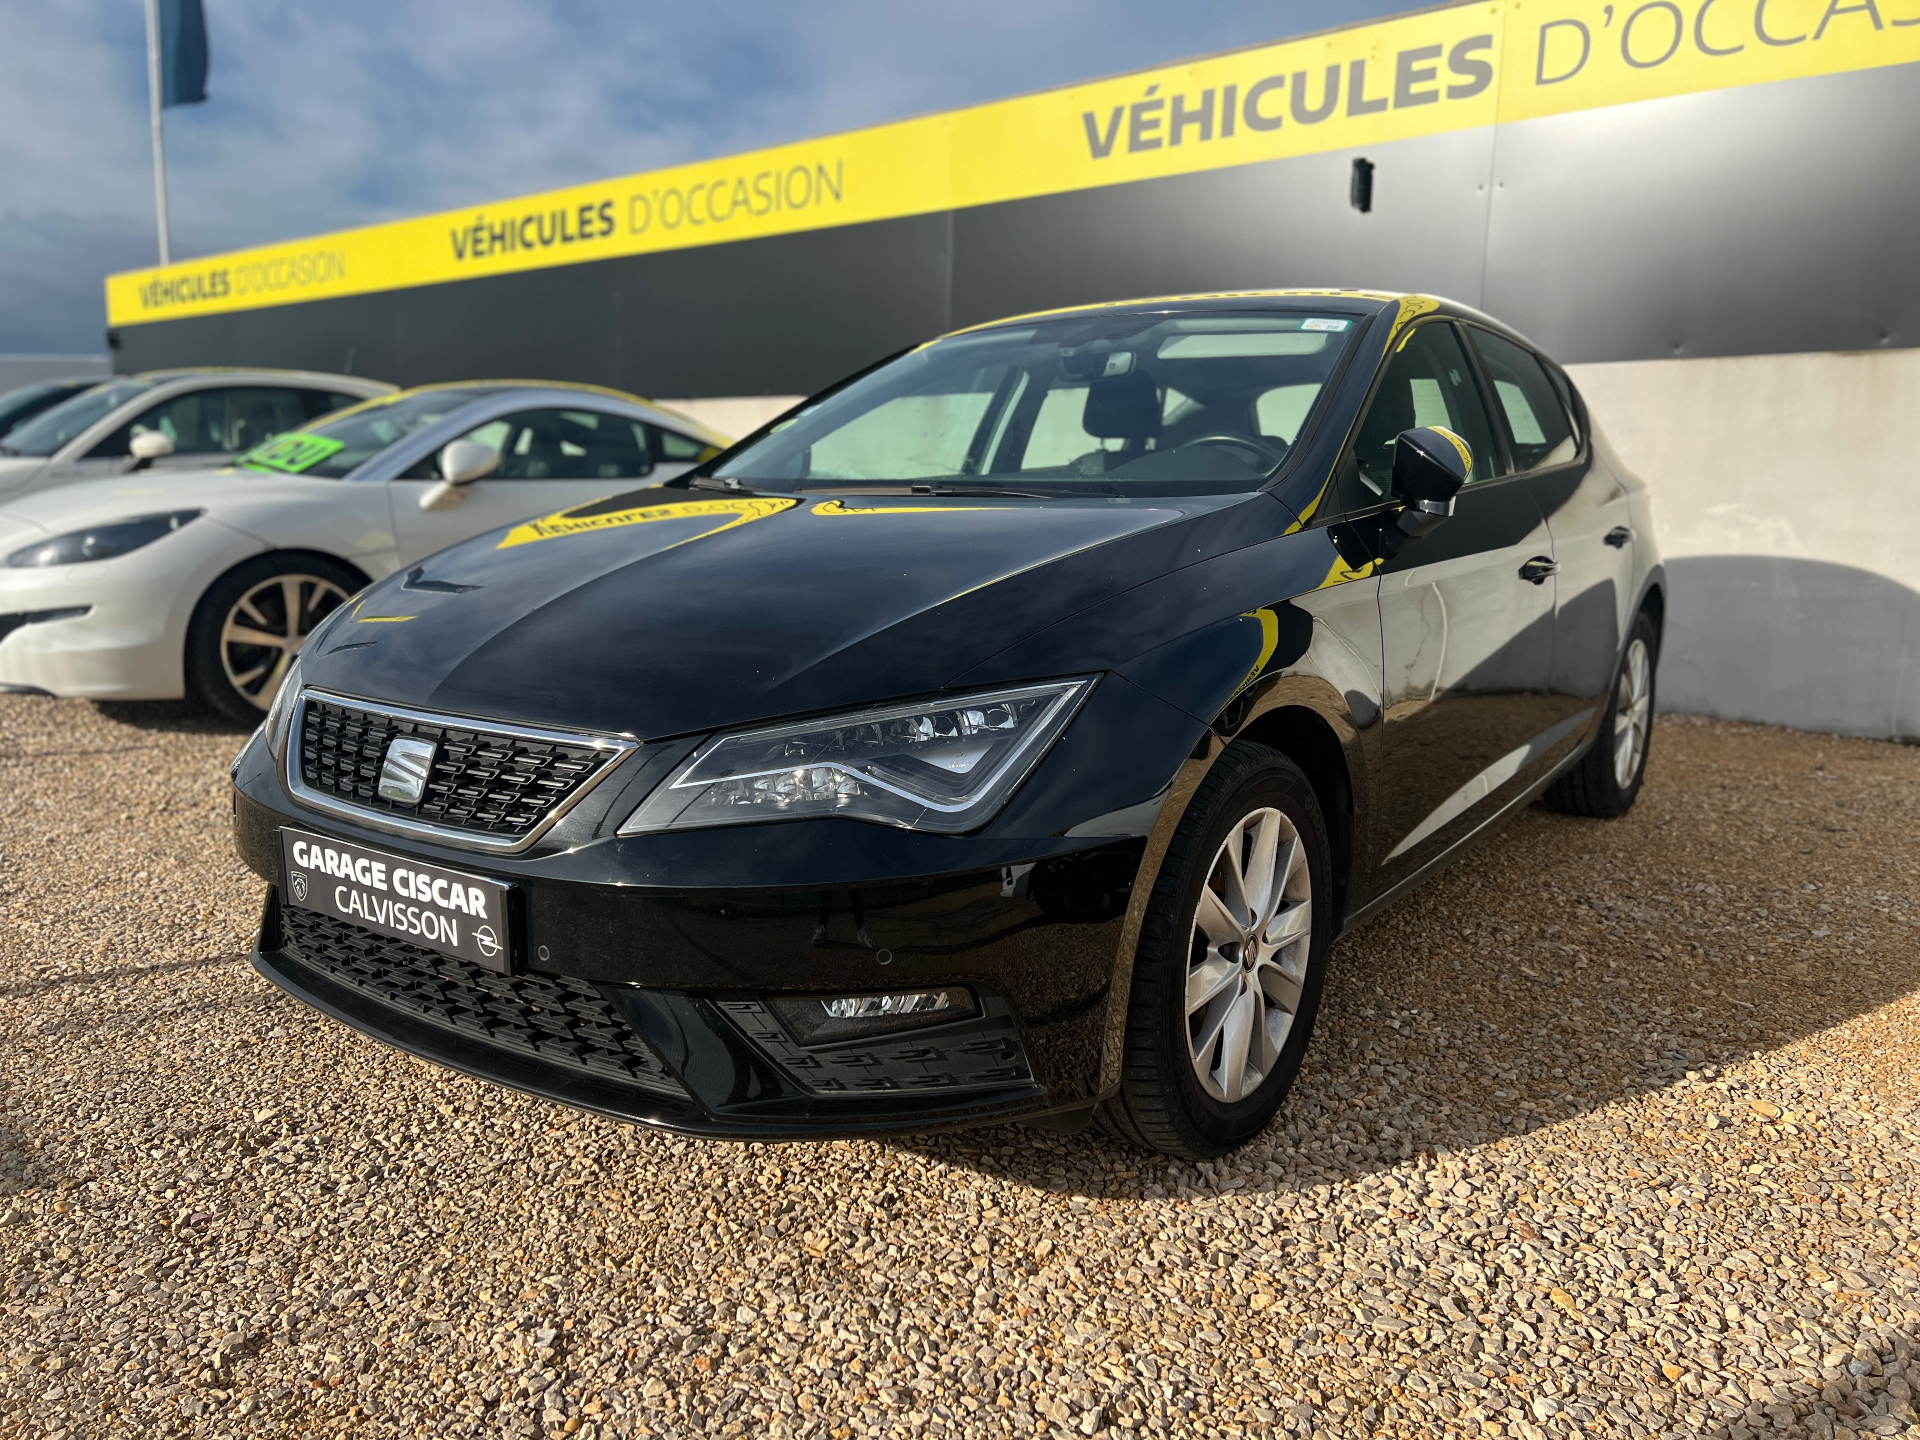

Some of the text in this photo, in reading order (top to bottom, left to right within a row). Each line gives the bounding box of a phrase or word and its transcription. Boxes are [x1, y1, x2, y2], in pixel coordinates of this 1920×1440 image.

[1082, 34, 1494, 160] VÉHICULES
[450, 159, 844, 261] VÉHICULES D'OCCASION
[138, 268, 231, 310] VÉHICULES
[292, 840, 488, 919] GARAGE CISCAR
[334, 885, 459, 947] CALVISSON
